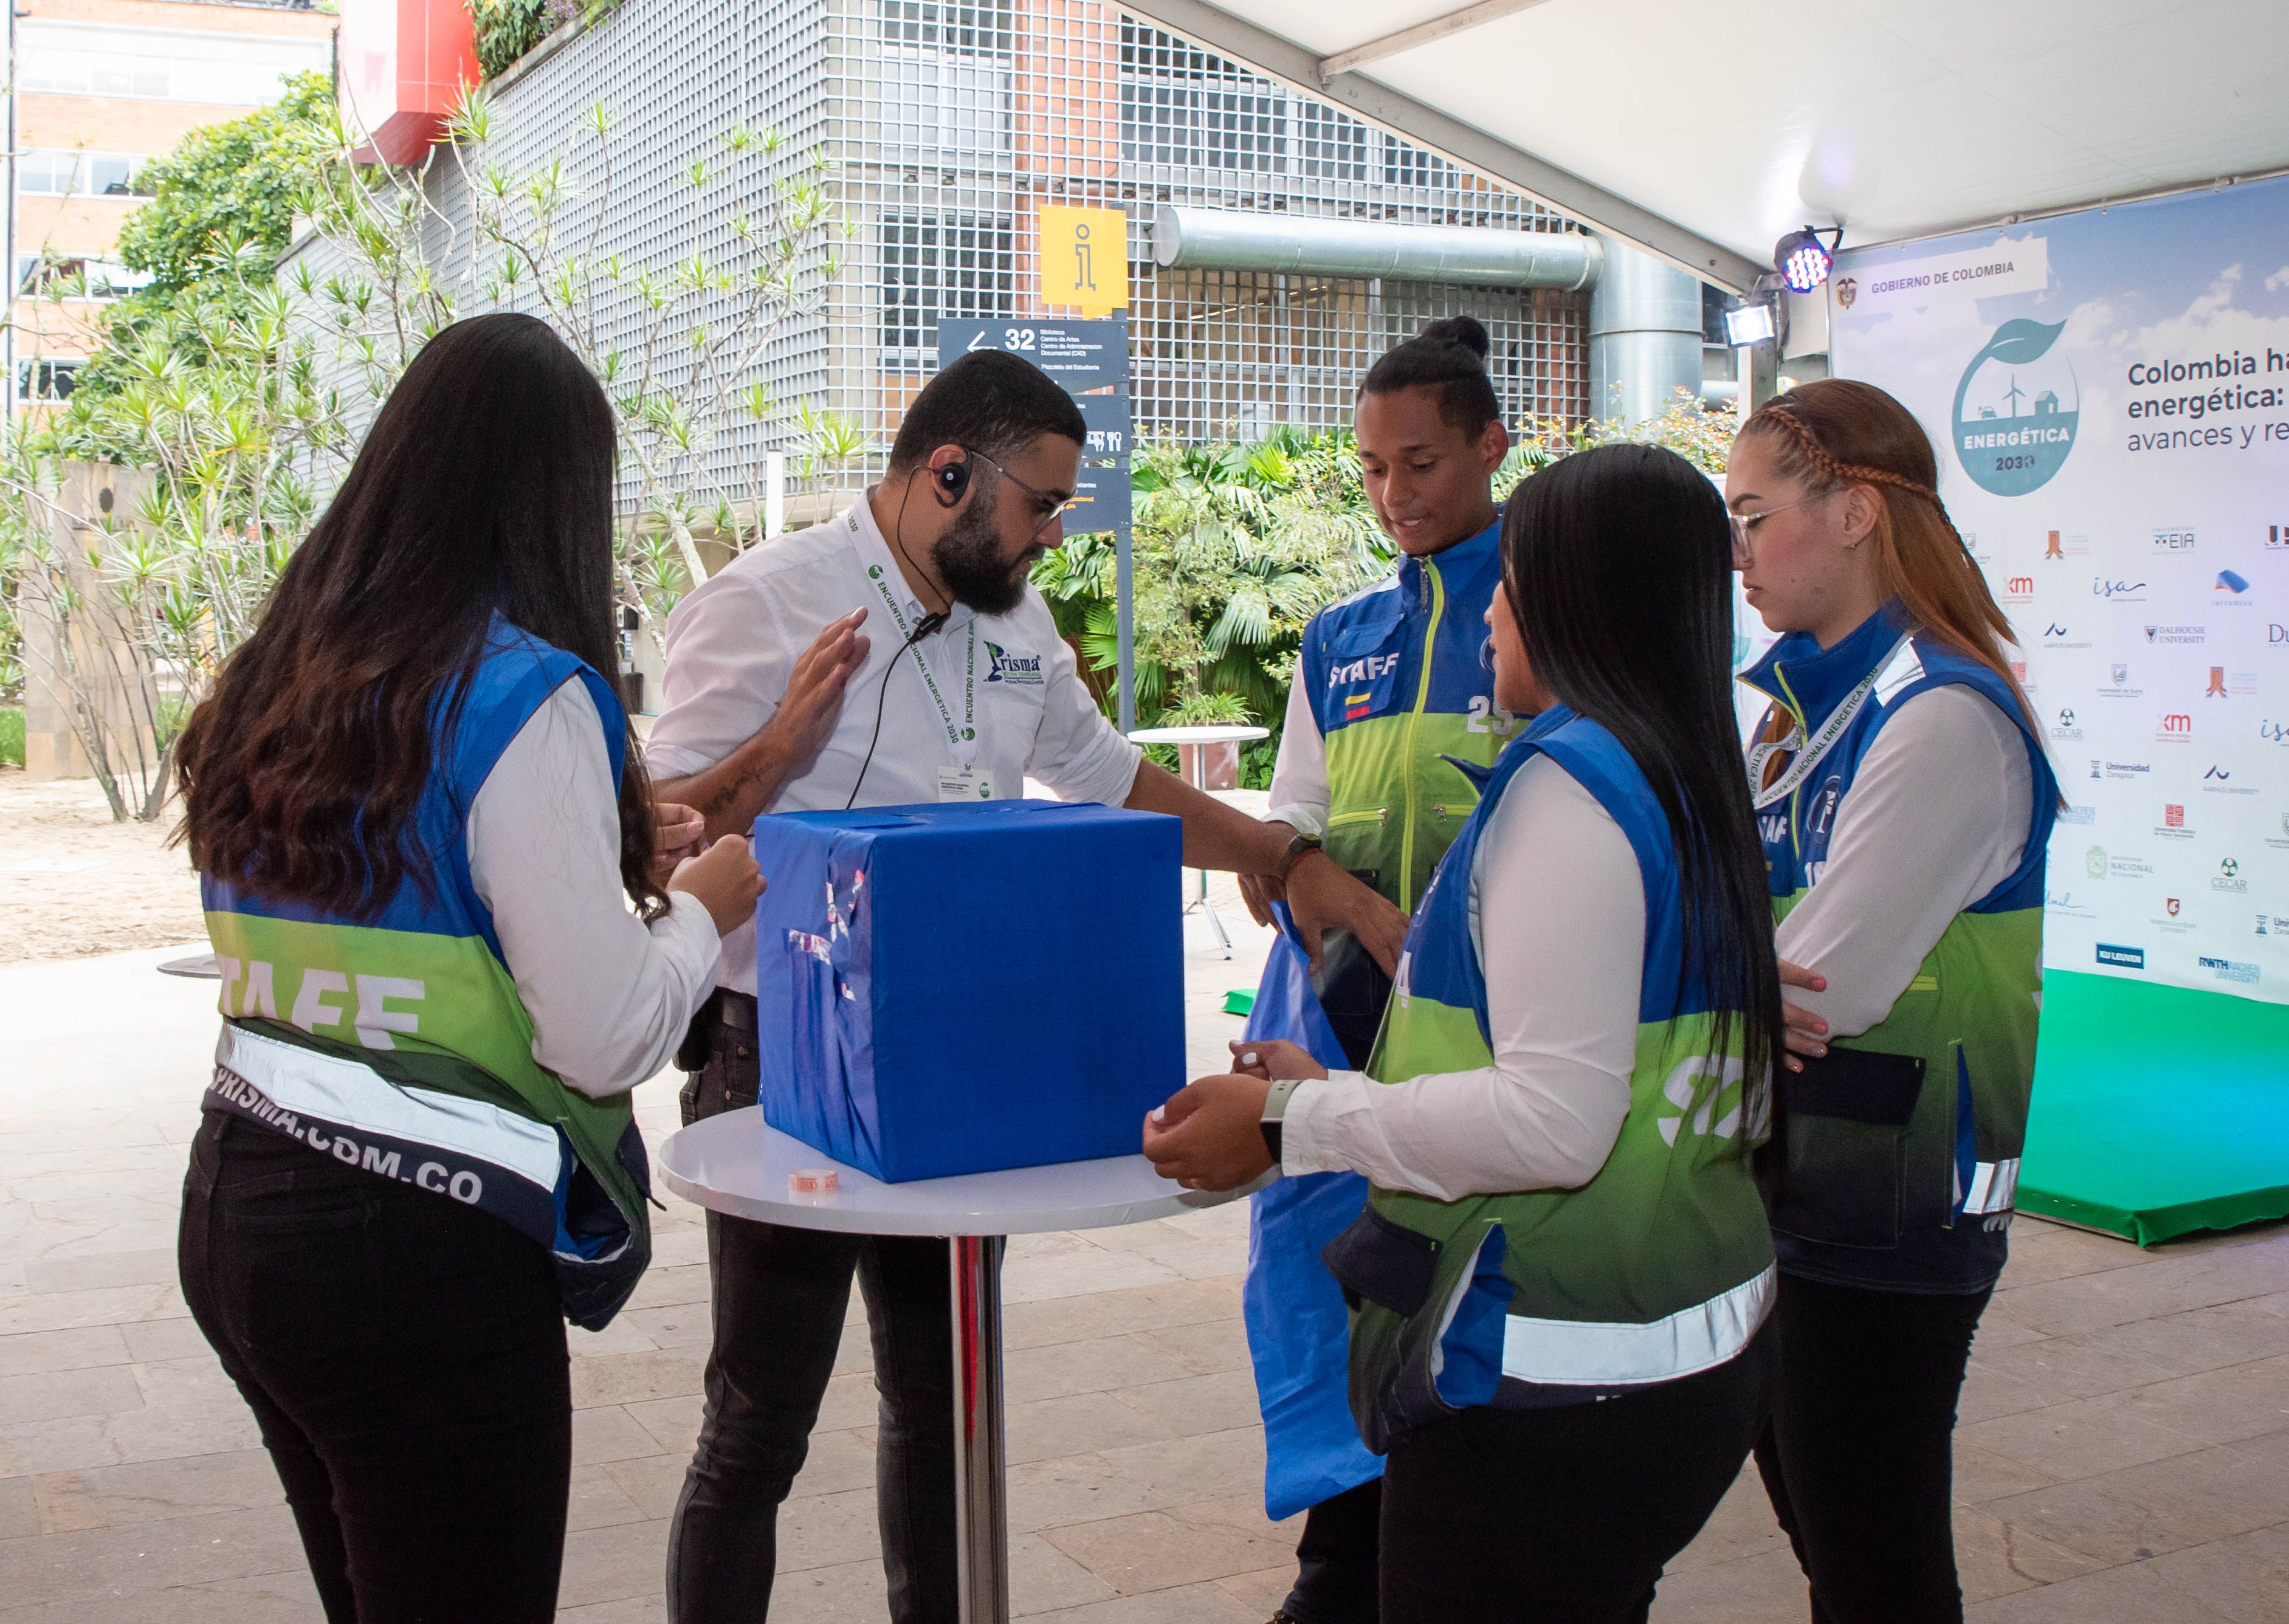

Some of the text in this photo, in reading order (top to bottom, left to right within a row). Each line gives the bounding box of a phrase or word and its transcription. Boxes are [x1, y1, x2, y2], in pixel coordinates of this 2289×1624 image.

[1871, 261, 2014, 294] GOBIERNO DE COLOMBIA
[1005, 328, 1036, 351] 32
[2128, 348, 2289, 386] Colombia h
[2128, 384, 2284, 419] energética:
[1964, 427, 2070, 450] ENERGÉTICA
[2127, 427, 2233, 452] avances
[2239, 424, 2256, 449] y
[2169, 534, 2194, 548] EIA
[2094, 577, 2146, 597] isa
[878, 581, 959, 744] ENCUENTRO NCIONAL ENERGETICA 2030
[1329, 652, 1400, 689] STAFF
[1797, 741, 1827, 776] NACIONAL
[1823, 690, 1864, 742] ENERGETICA
[1861, 667, 1878, 689] 2030
[2051, 728, 2083, 739] CECAR
[2106, 762, 2150, 772] Universidad
[2110, 862, 2155, 873] NACIONAL
[2211, 877, 2248, 891] CECAR
[215, 953, 425, 1050] TAFF
